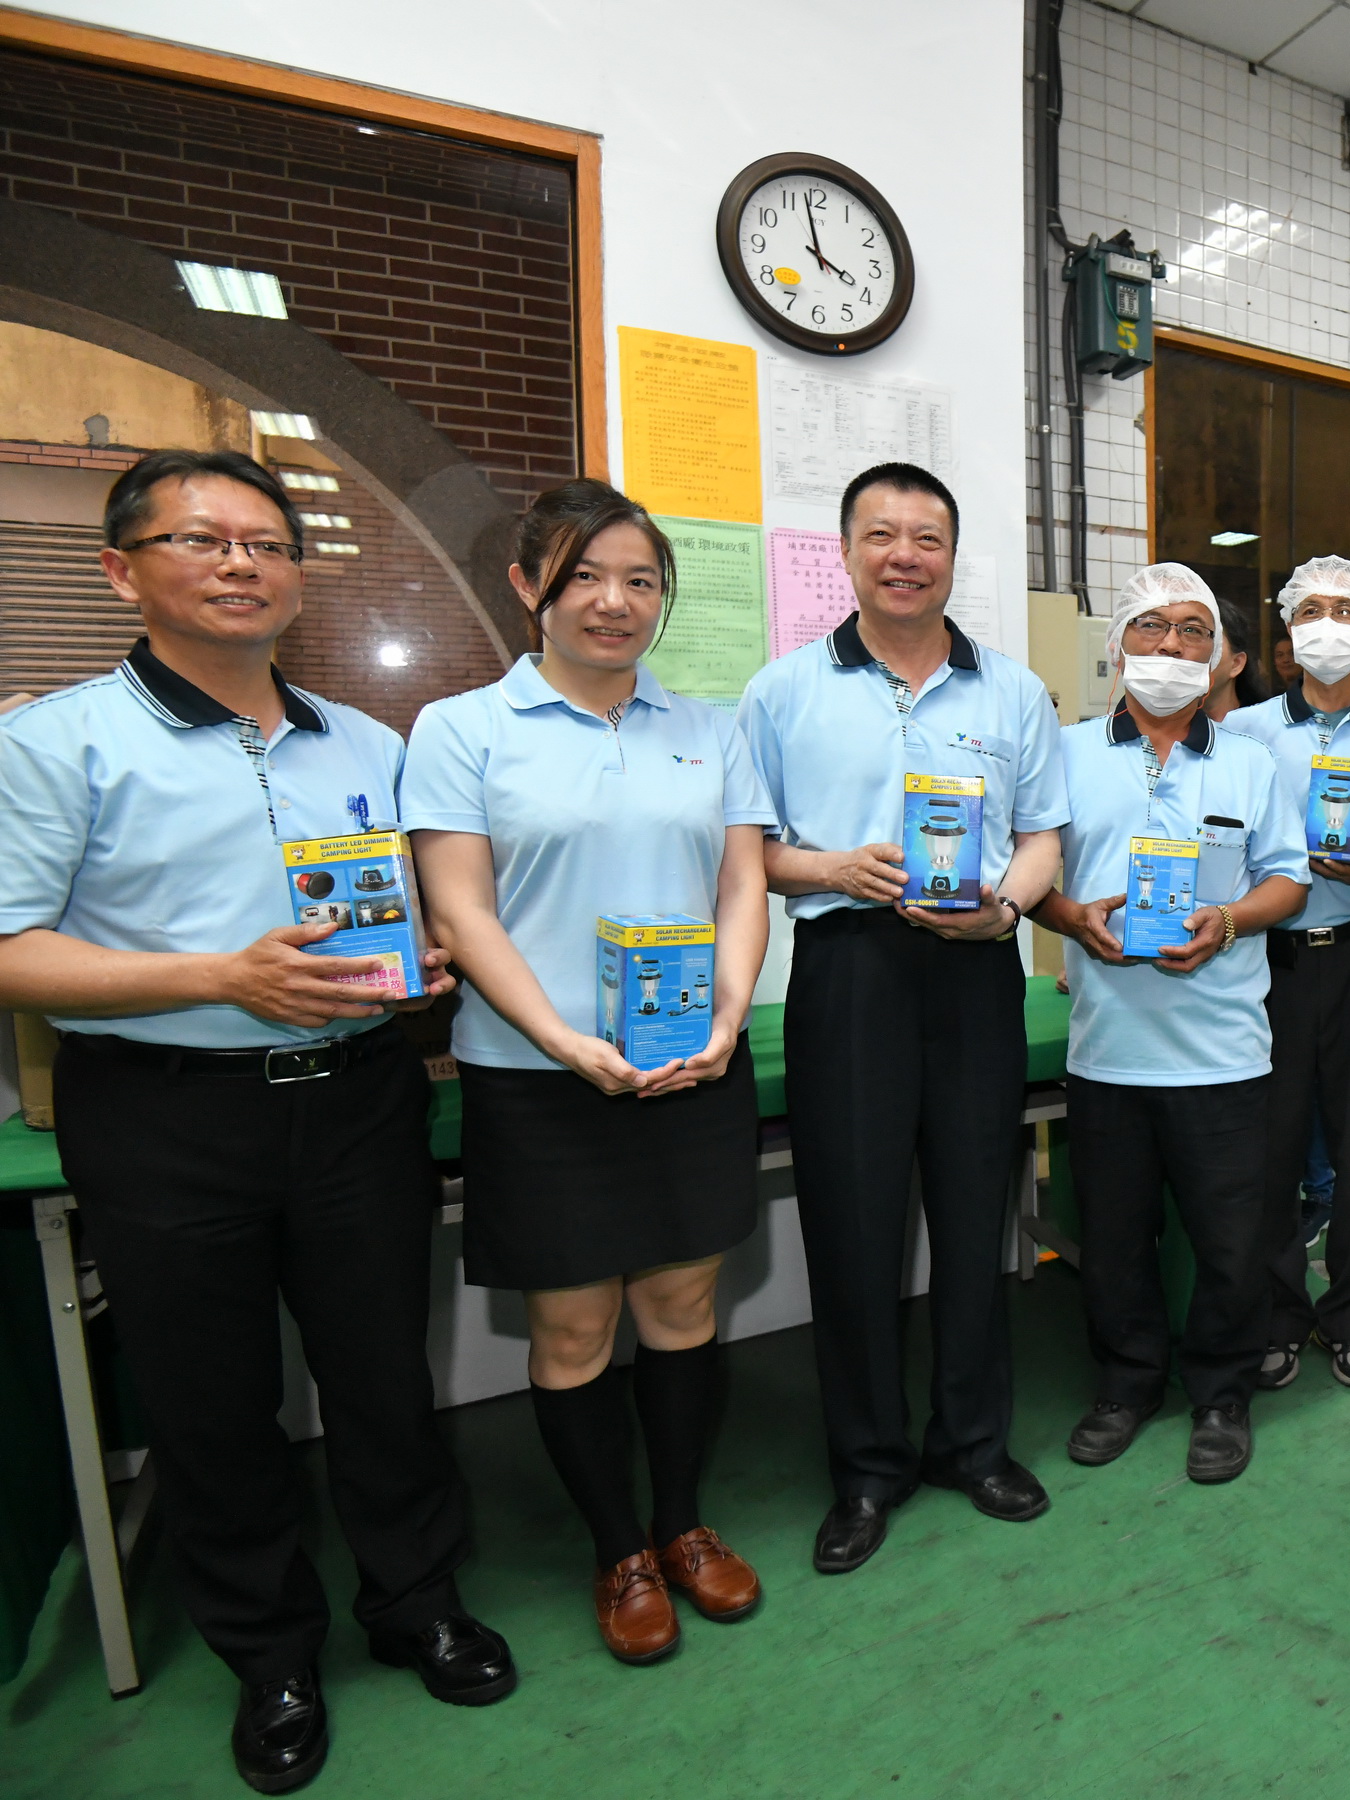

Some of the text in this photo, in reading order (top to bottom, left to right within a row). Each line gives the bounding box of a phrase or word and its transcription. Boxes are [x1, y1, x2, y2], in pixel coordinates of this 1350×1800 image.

[782, 190, 795, 211] 11
[809, 188, 827, 210] 12
[759, 206, 778, 228] 10
[845, 205, 849, 224] 1
[751, 234, 766, 253] 9
[861, 228, 875, 248] 2
[760, 265, 775, 285] 8
[868, 259, 882, 279] 3
[783, 291, 797, 311] 7
[859, 287, 873, 305] 4
[811, 305, 826, 324] 6
[840, 303, 854, 322] 5
[1117, 320, 1138, 349] 5
[970, 738, 983, 747] TTL
[320, 841, 348, 850] BATTERY
[364, 837, 393, 845] DIMMING
[321, 848, 352, 857] CAMPING
